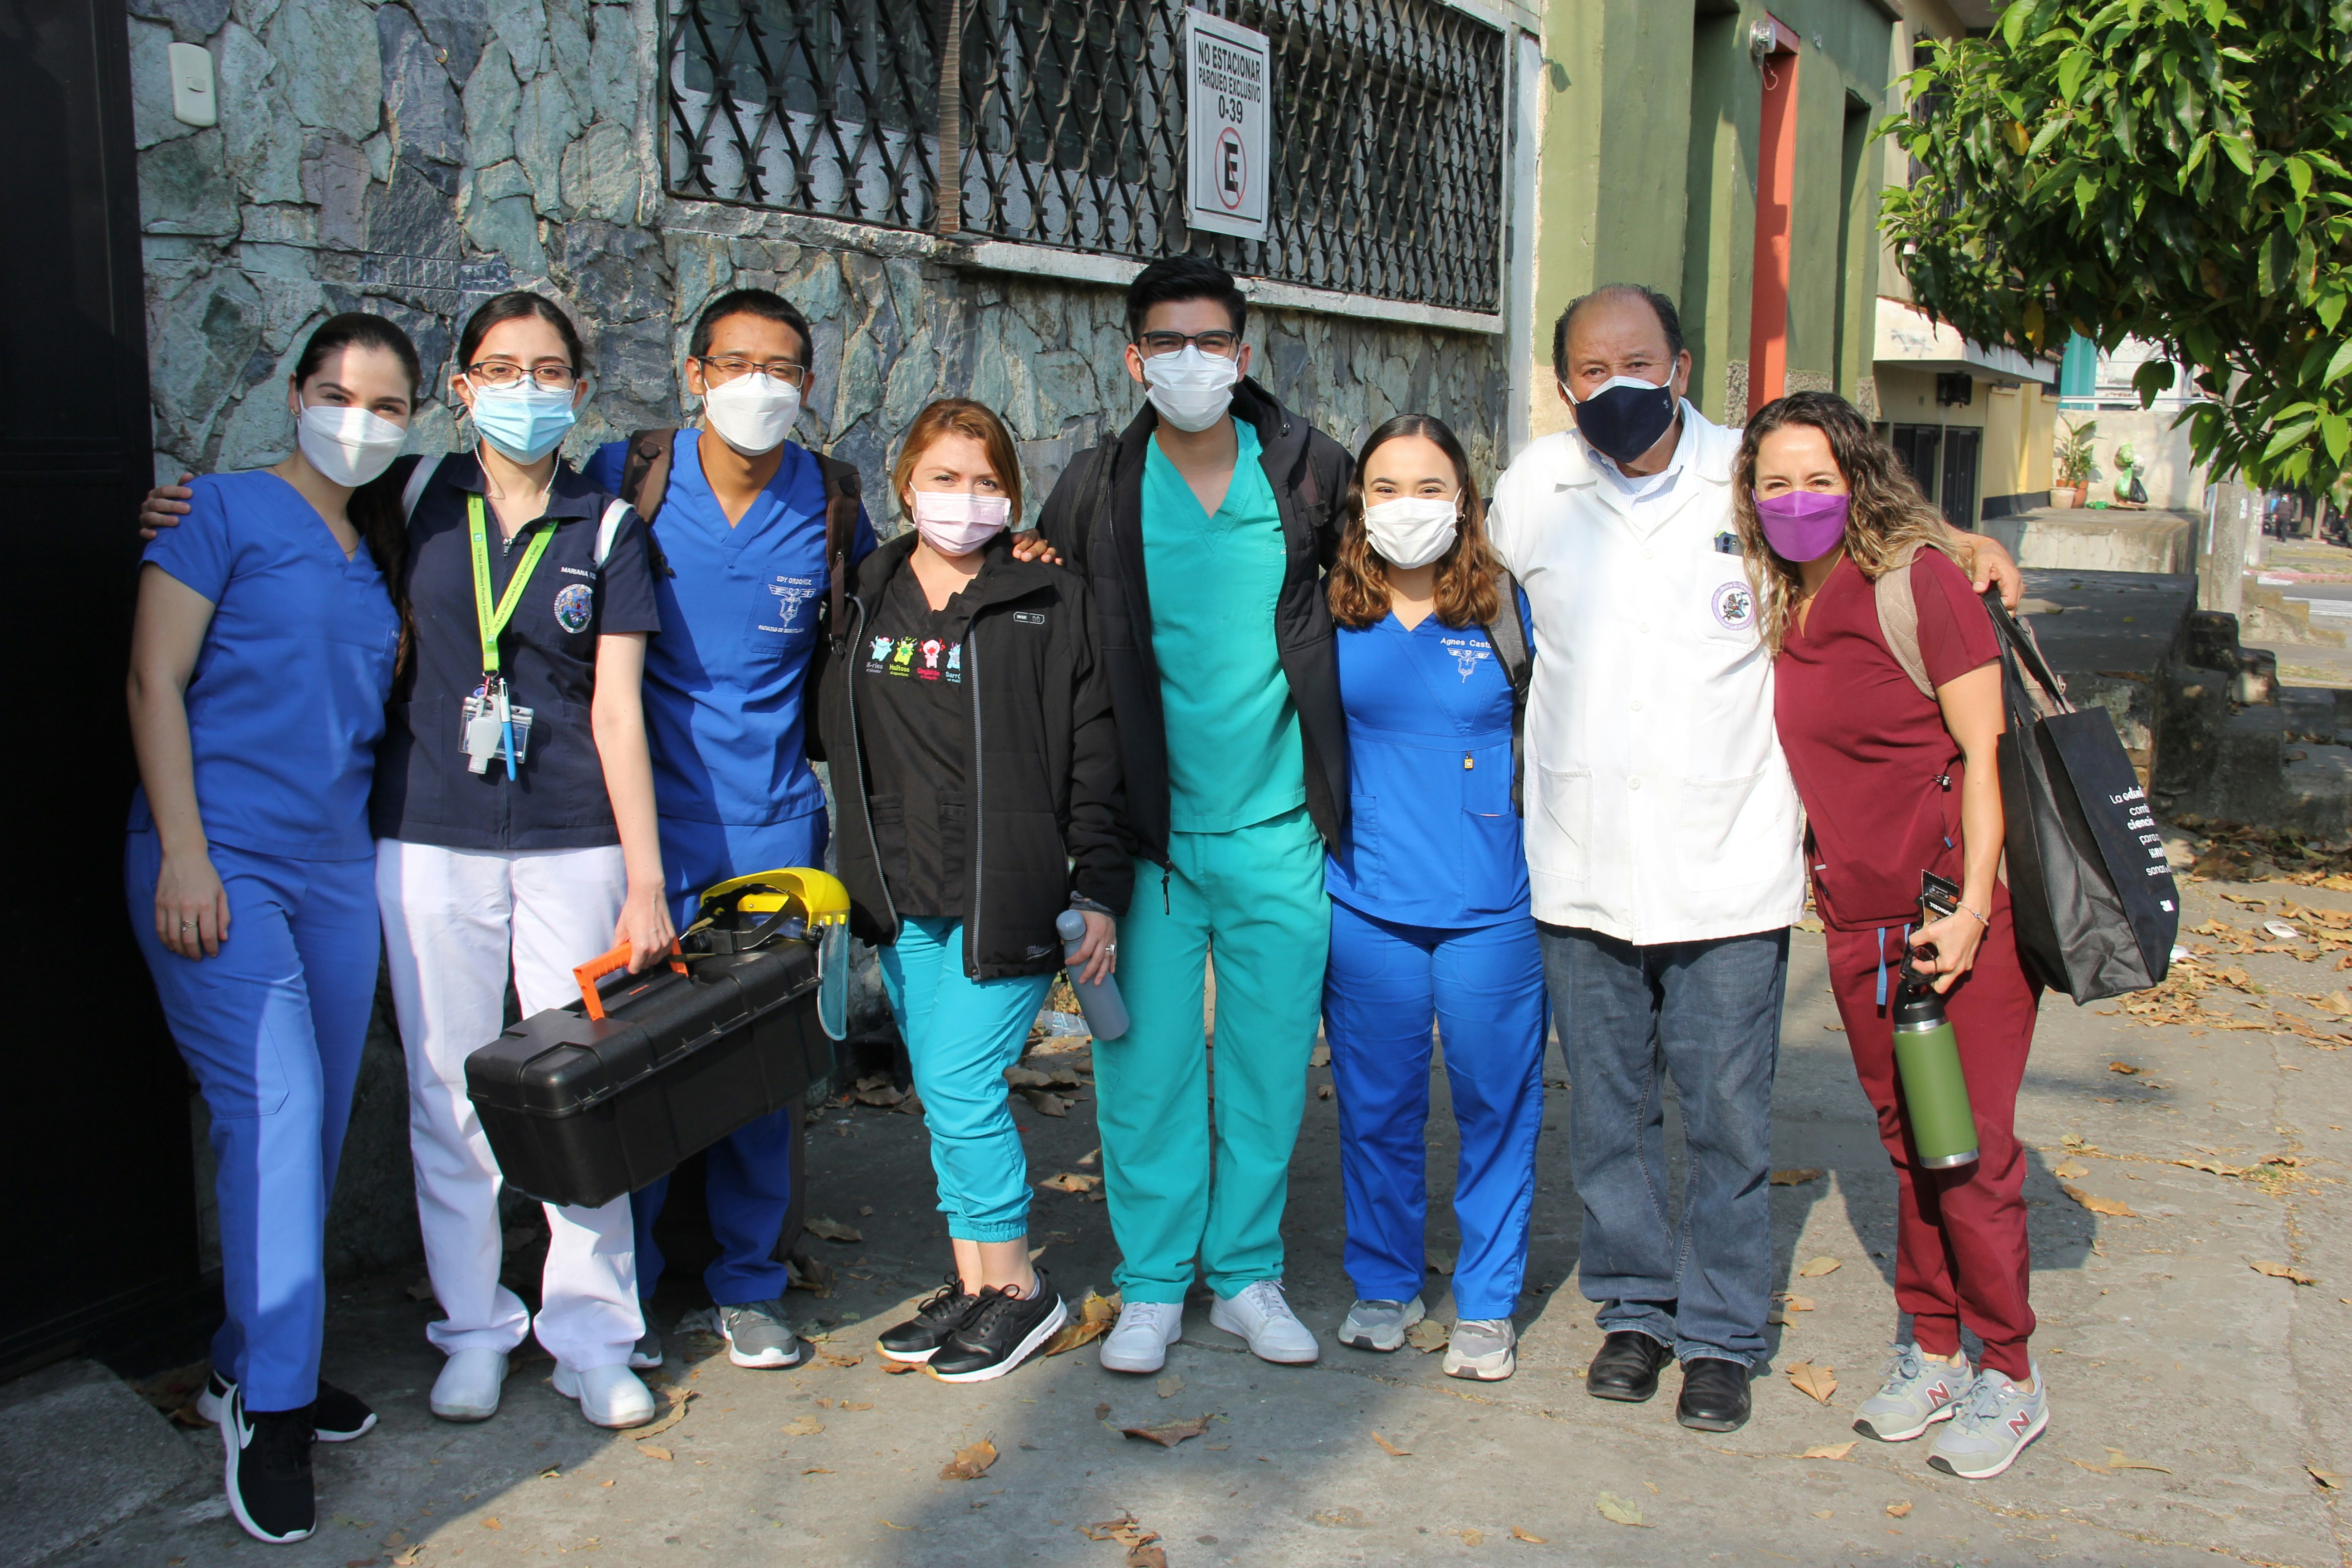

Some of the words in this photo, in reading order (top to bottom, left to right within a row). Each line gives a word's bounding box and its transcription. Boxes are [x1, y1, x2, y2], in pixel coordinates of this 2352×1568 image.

[1198, 40, 1210, 66] NO
[1212, 45, 1260, 83] ESTACIONAR
[1199, 67, 1227, 93] PARQUEO
[1229, 77, 1261, 103] EXCLUSIVO
[1219, 95, 1243, 124] 0-39
[1225, 141, 1238, 192] E
[513, 574, 524, 590] Practice
[521, 556, 533, 574] Solutions
[530, 544, 539, 556] Group
[561, 567, 588, 577] MARIANA
[1440, 637, 1465, 646] Agnes
[889, 664, 910, 672] Halitoso
[2109, 794, 2123, 804] La
[2146, 865, 2166, 876] sanas
[2160, 900, 2175, 912] 3M
